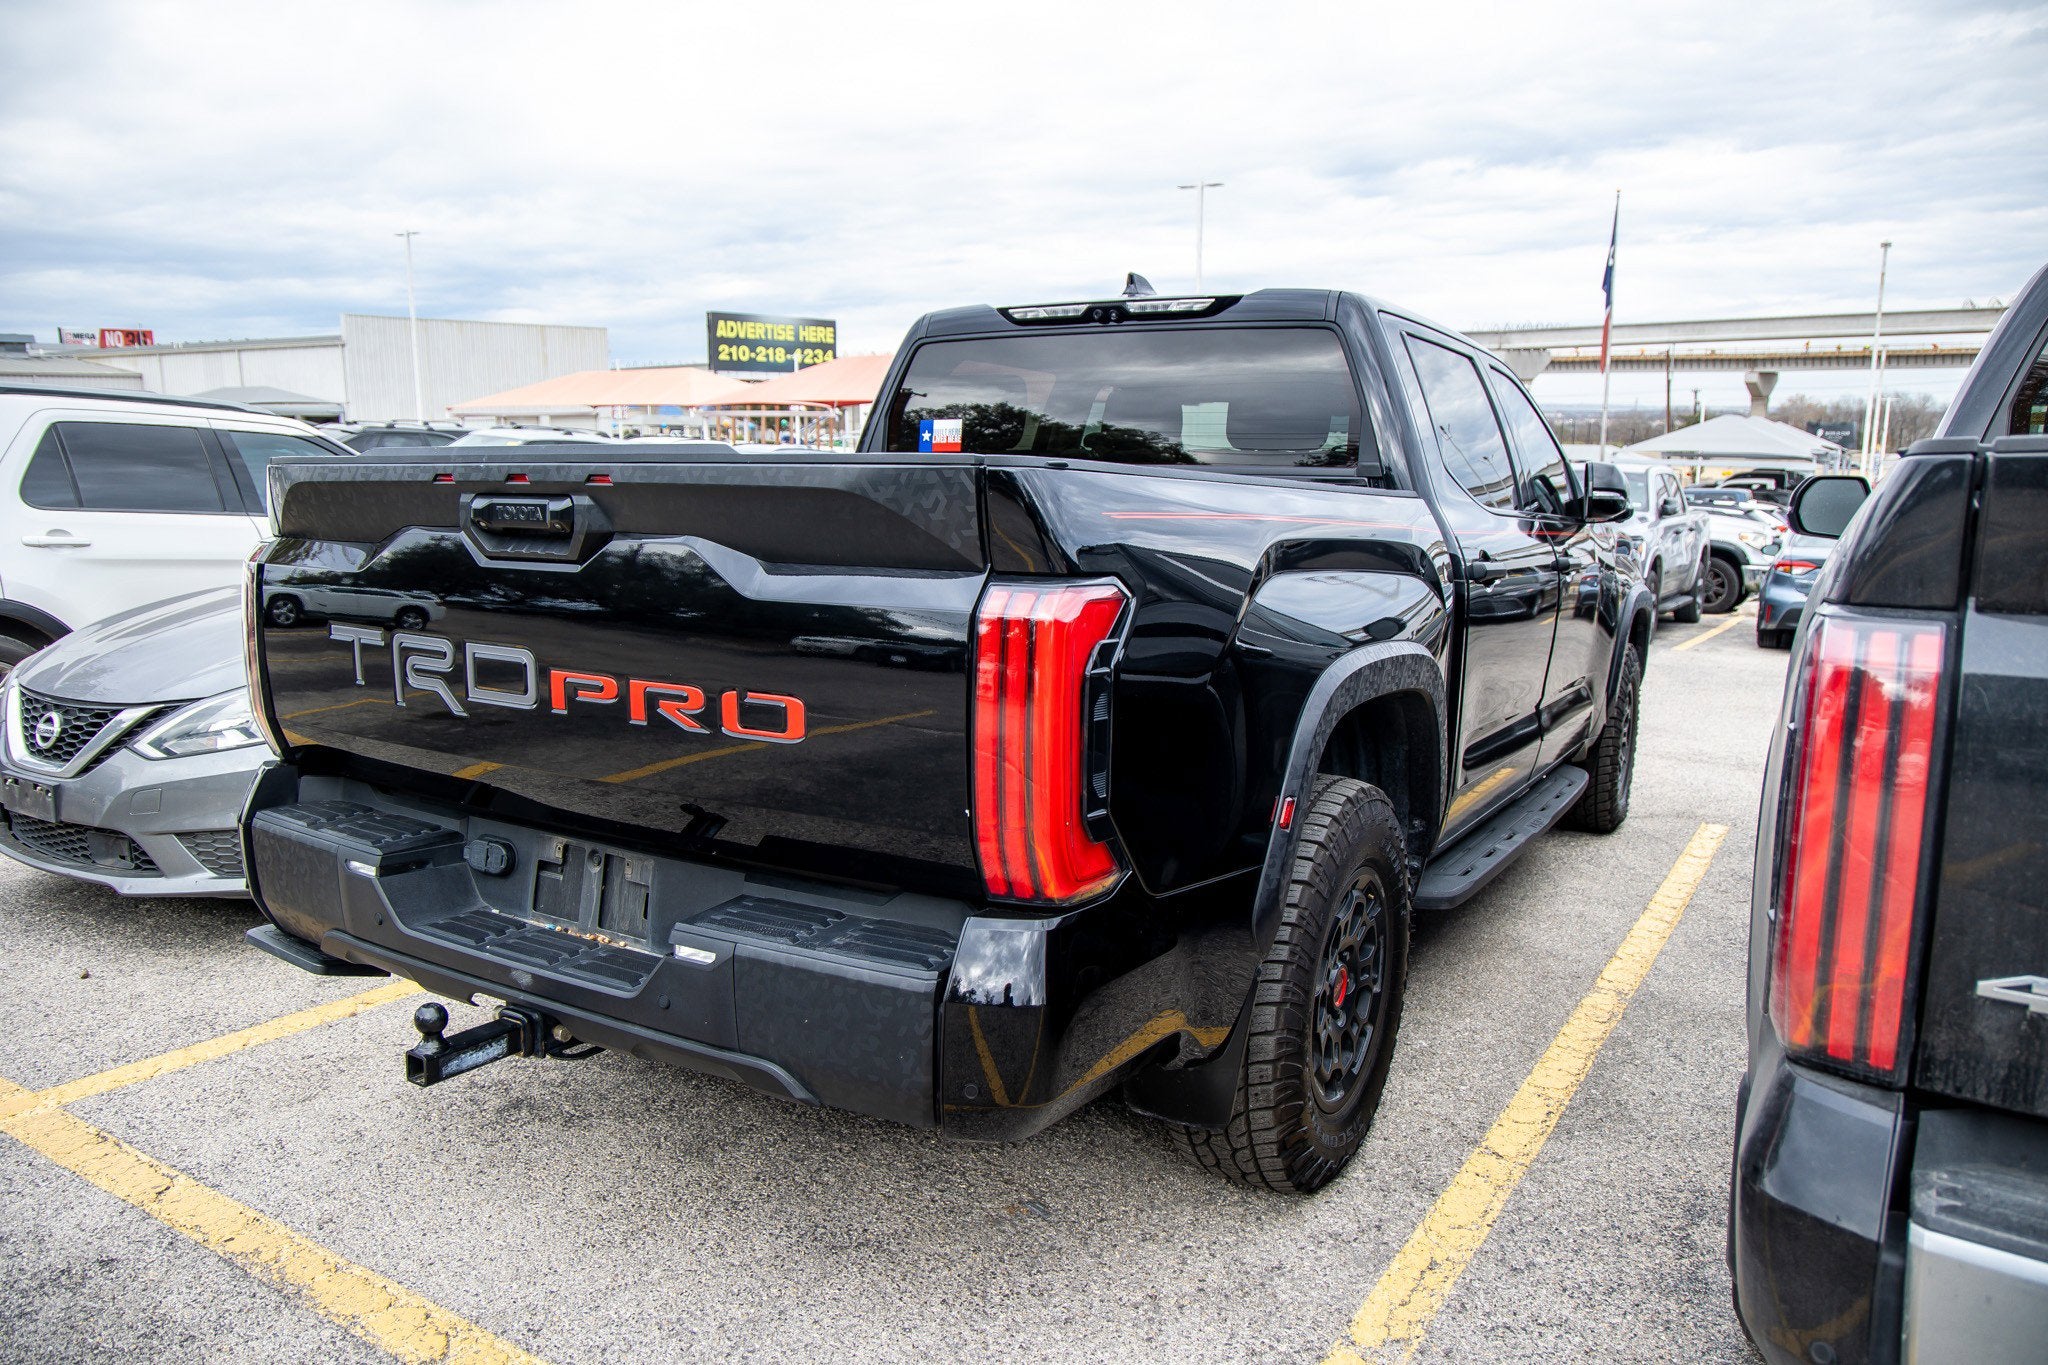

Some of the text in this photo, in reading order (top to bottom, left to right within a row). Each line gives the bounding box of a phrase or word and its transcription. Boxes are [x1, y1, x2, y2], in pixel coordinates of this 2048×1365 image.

[104, 330, 124, 348] NO
[716, 320, 834, 343] ADVERTISE HERE
[496, 505, 543, 521] TOYOTA
[328, 621, 808, 745] TRD PRO
